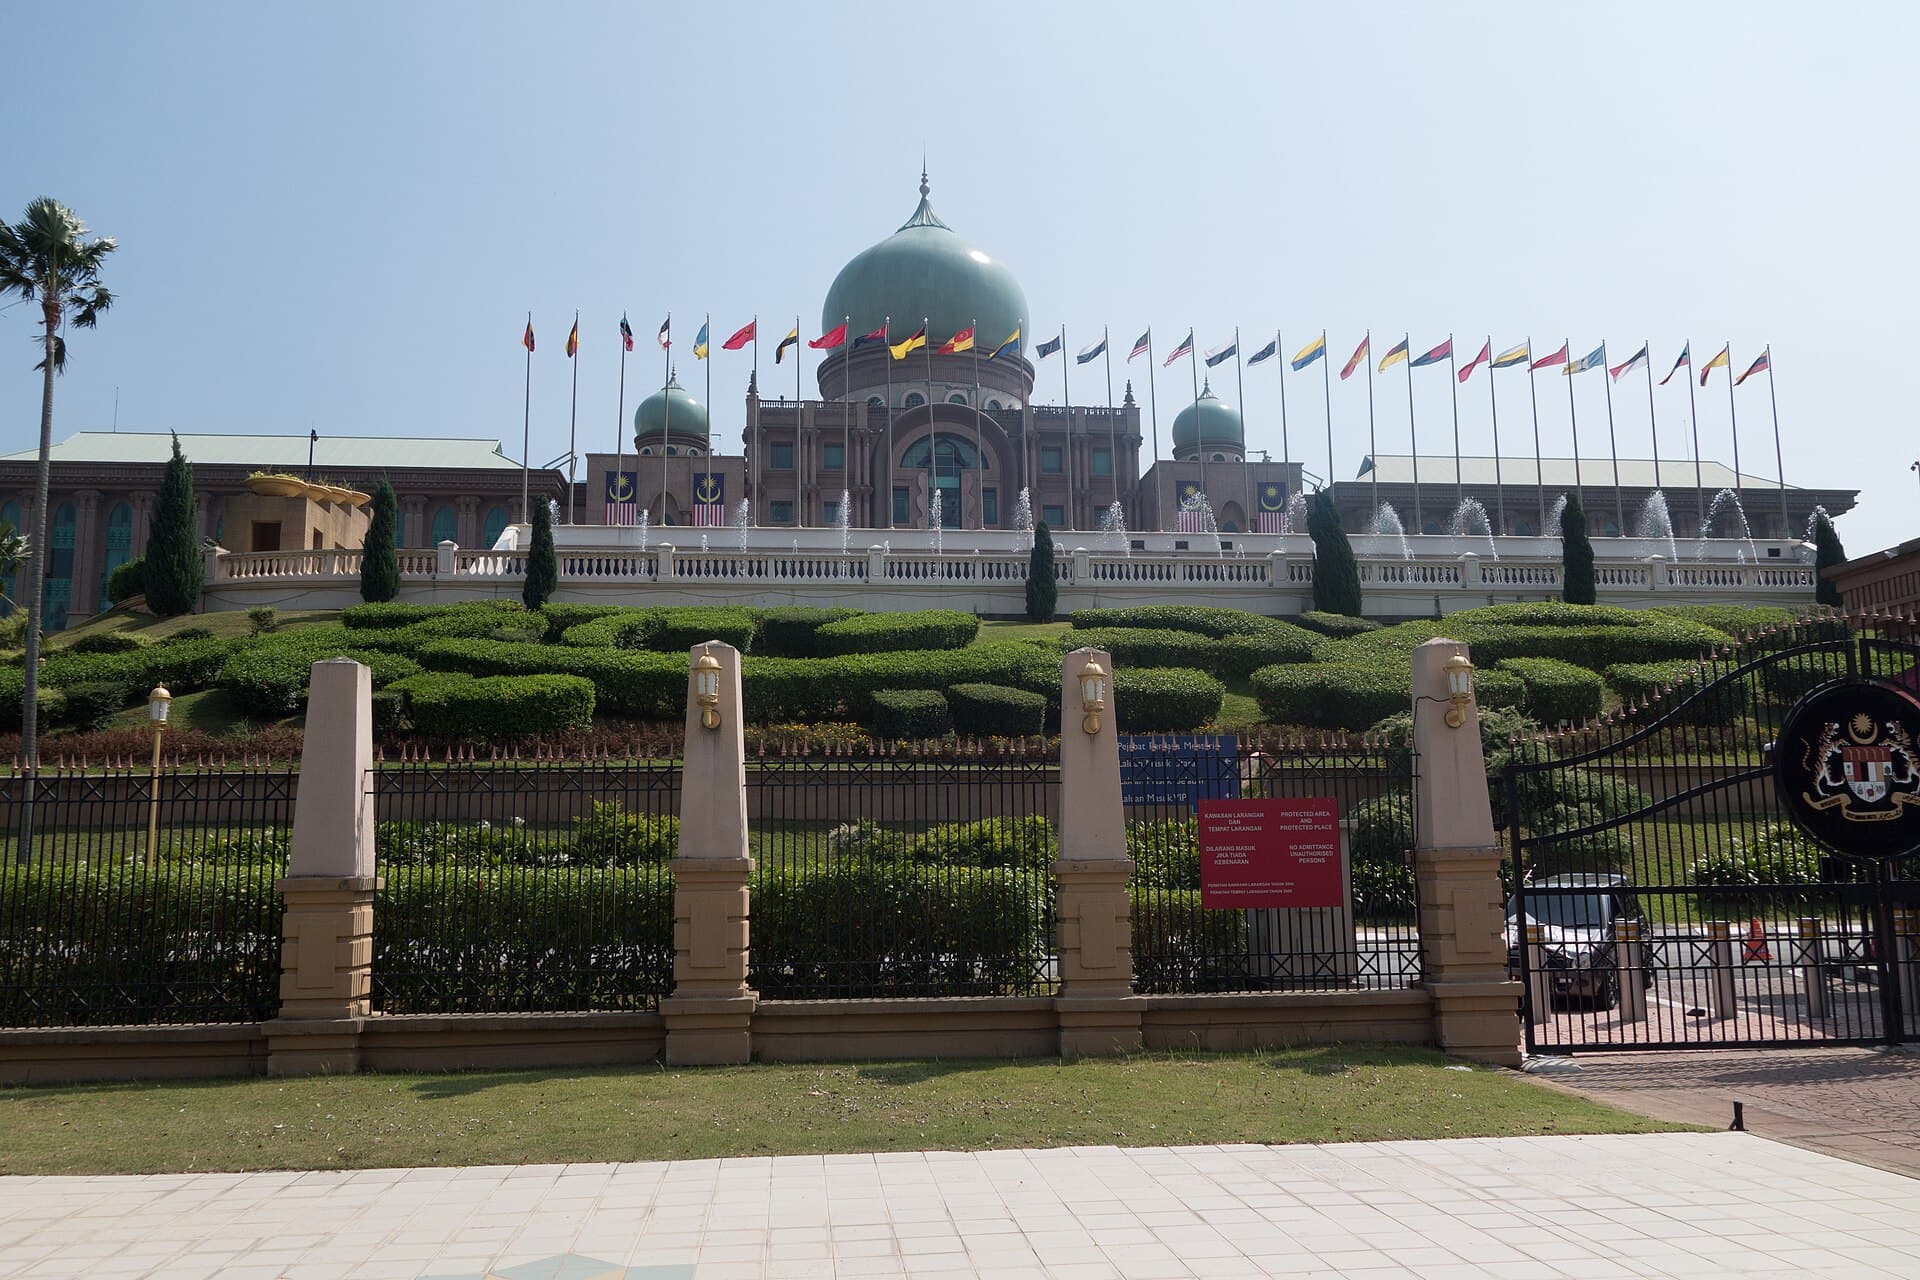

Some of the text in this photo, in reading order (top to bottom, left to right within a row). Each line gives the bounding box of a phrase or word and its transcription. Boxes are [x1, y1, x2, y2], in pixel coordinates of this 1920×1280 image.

[1118, 742, 1146, 752] Pejbat
[1183, 741, 1215, 750] Mntri
[1121, 794, 1144, 802] alan
